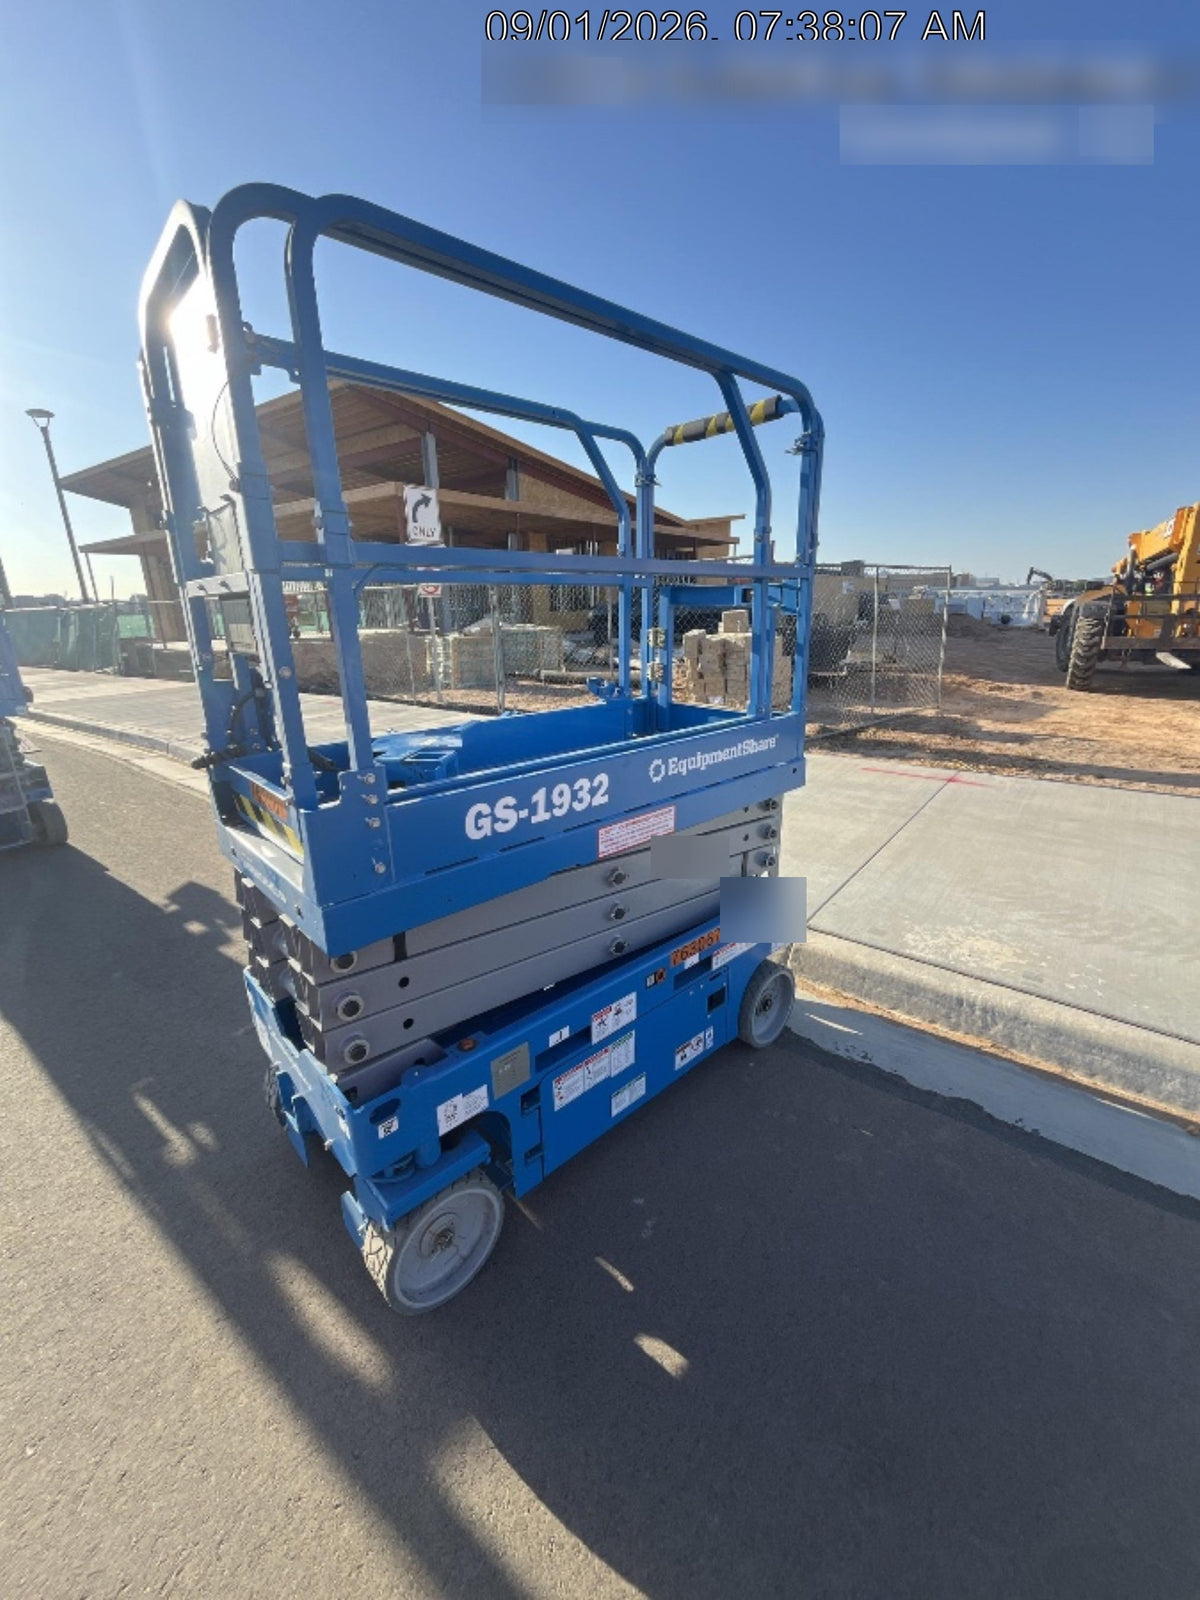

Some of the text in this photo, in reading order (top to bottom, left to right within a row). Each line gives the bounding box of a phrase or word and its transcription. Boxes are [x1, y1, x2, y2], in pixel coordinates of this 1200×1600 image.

[413, 526, 436, 537] ONLY
[668, 737, 776, 776] EquipmentShare
[465, 773, 609, 840] GS-1932
